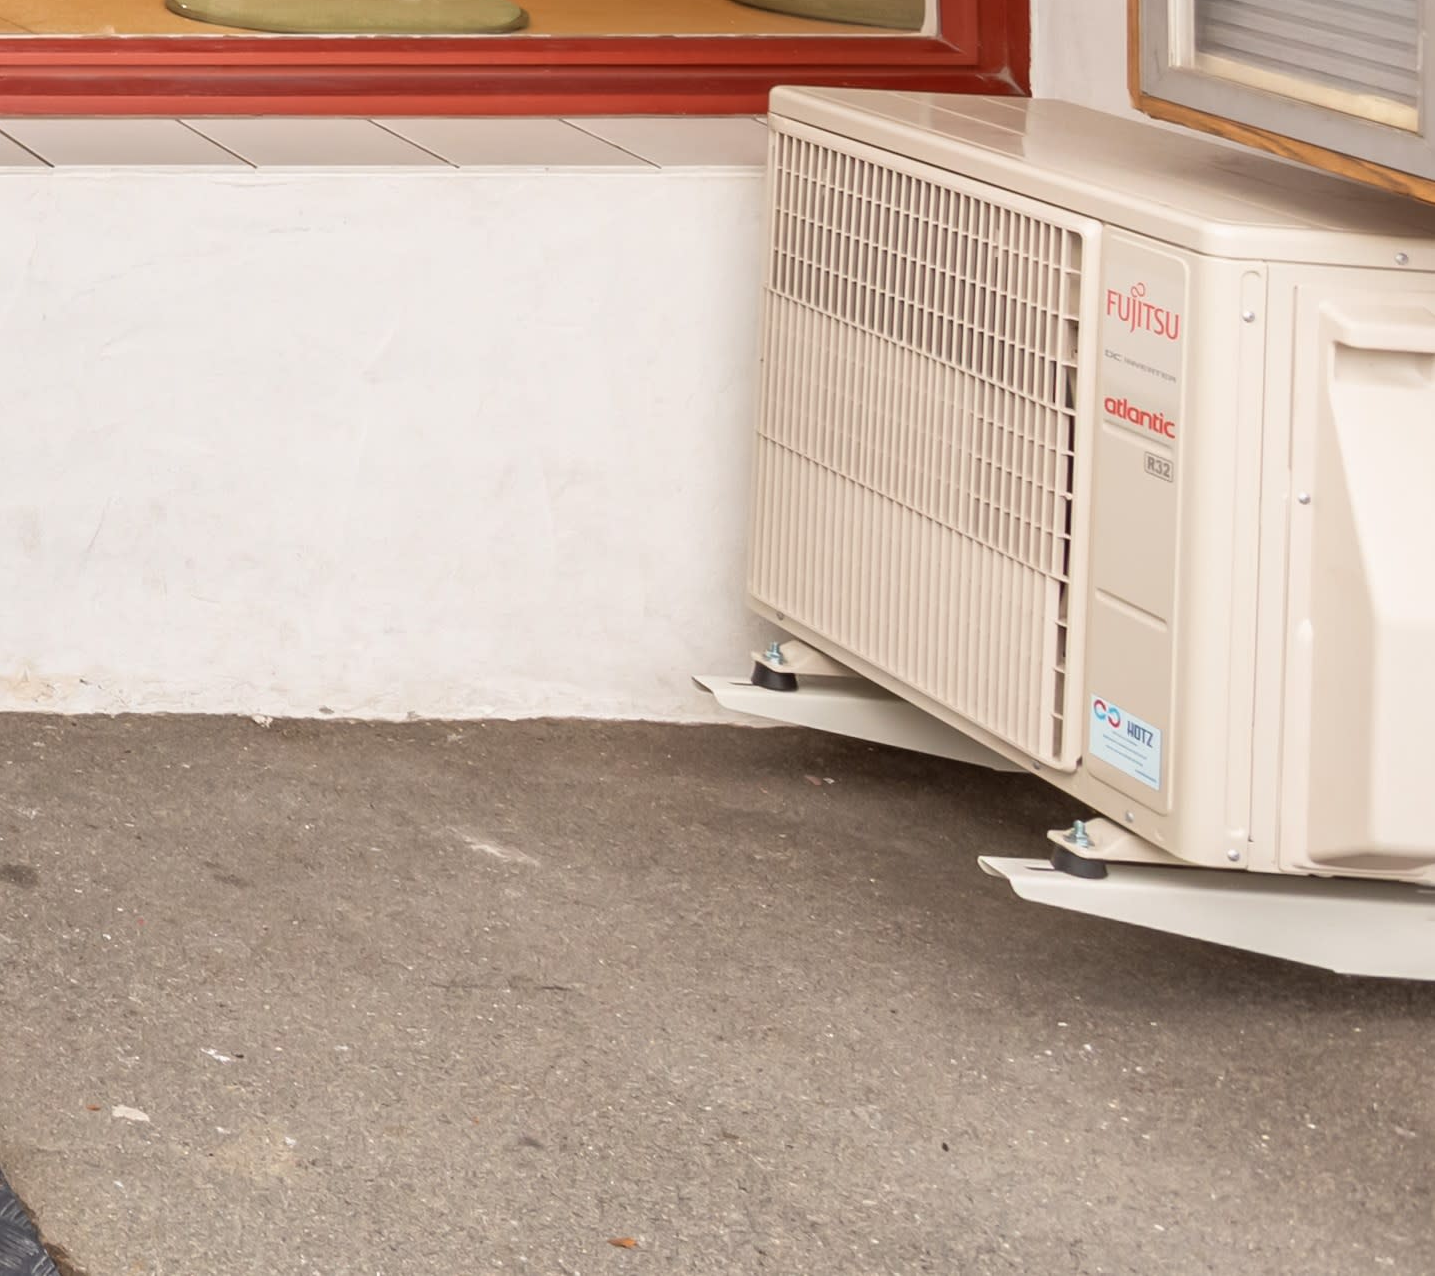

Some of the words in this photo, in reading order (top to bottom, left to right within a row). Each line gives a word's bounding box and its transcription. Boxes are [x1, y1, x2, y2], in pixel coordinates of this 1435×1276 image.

[1106, 282, 1180, 340] FUJITSU
[1105, 349, 1122, 362] DC
[1124, 357, 1177, 383] INVERTER
[1104, 396, 1175, 439] atlantic
[1147, 456, 1171, 478] R32
